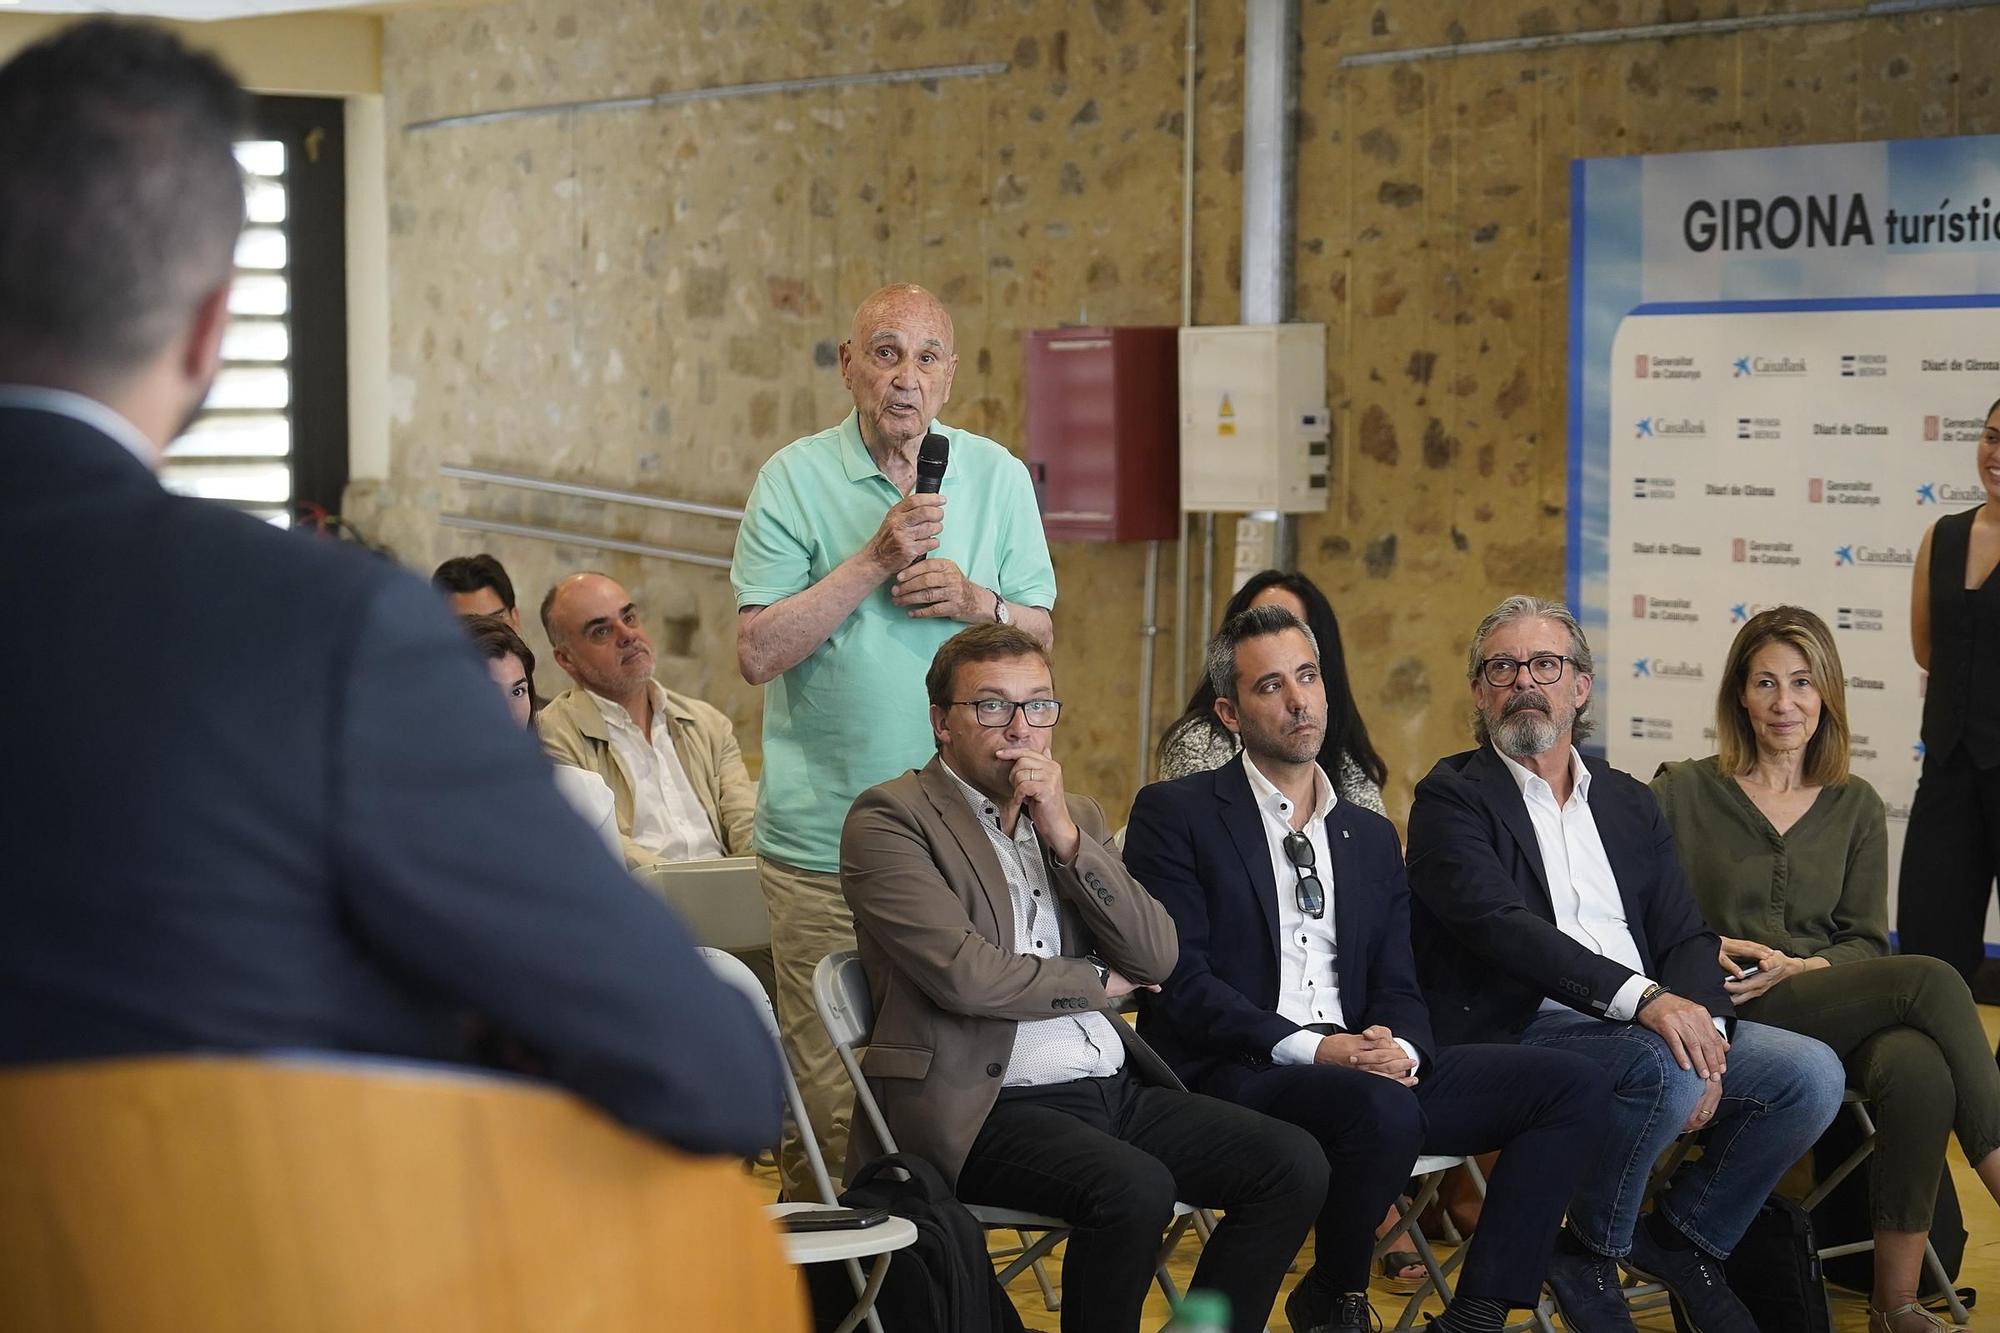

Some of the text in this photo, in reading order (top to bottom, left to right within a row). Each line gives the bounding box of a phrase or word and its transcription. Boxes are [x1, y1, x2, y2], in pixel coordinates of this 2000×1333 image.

[1684, 193, 1874, 252] GIRONA
[1753, 356, 1807, 372] CaixaBank
[1921, 359, 2000, 371] Diari de Girona
[1813, 424, 1888, 435] Diari de Girona
[1939, 484, 1987, 500] CaixaBa
